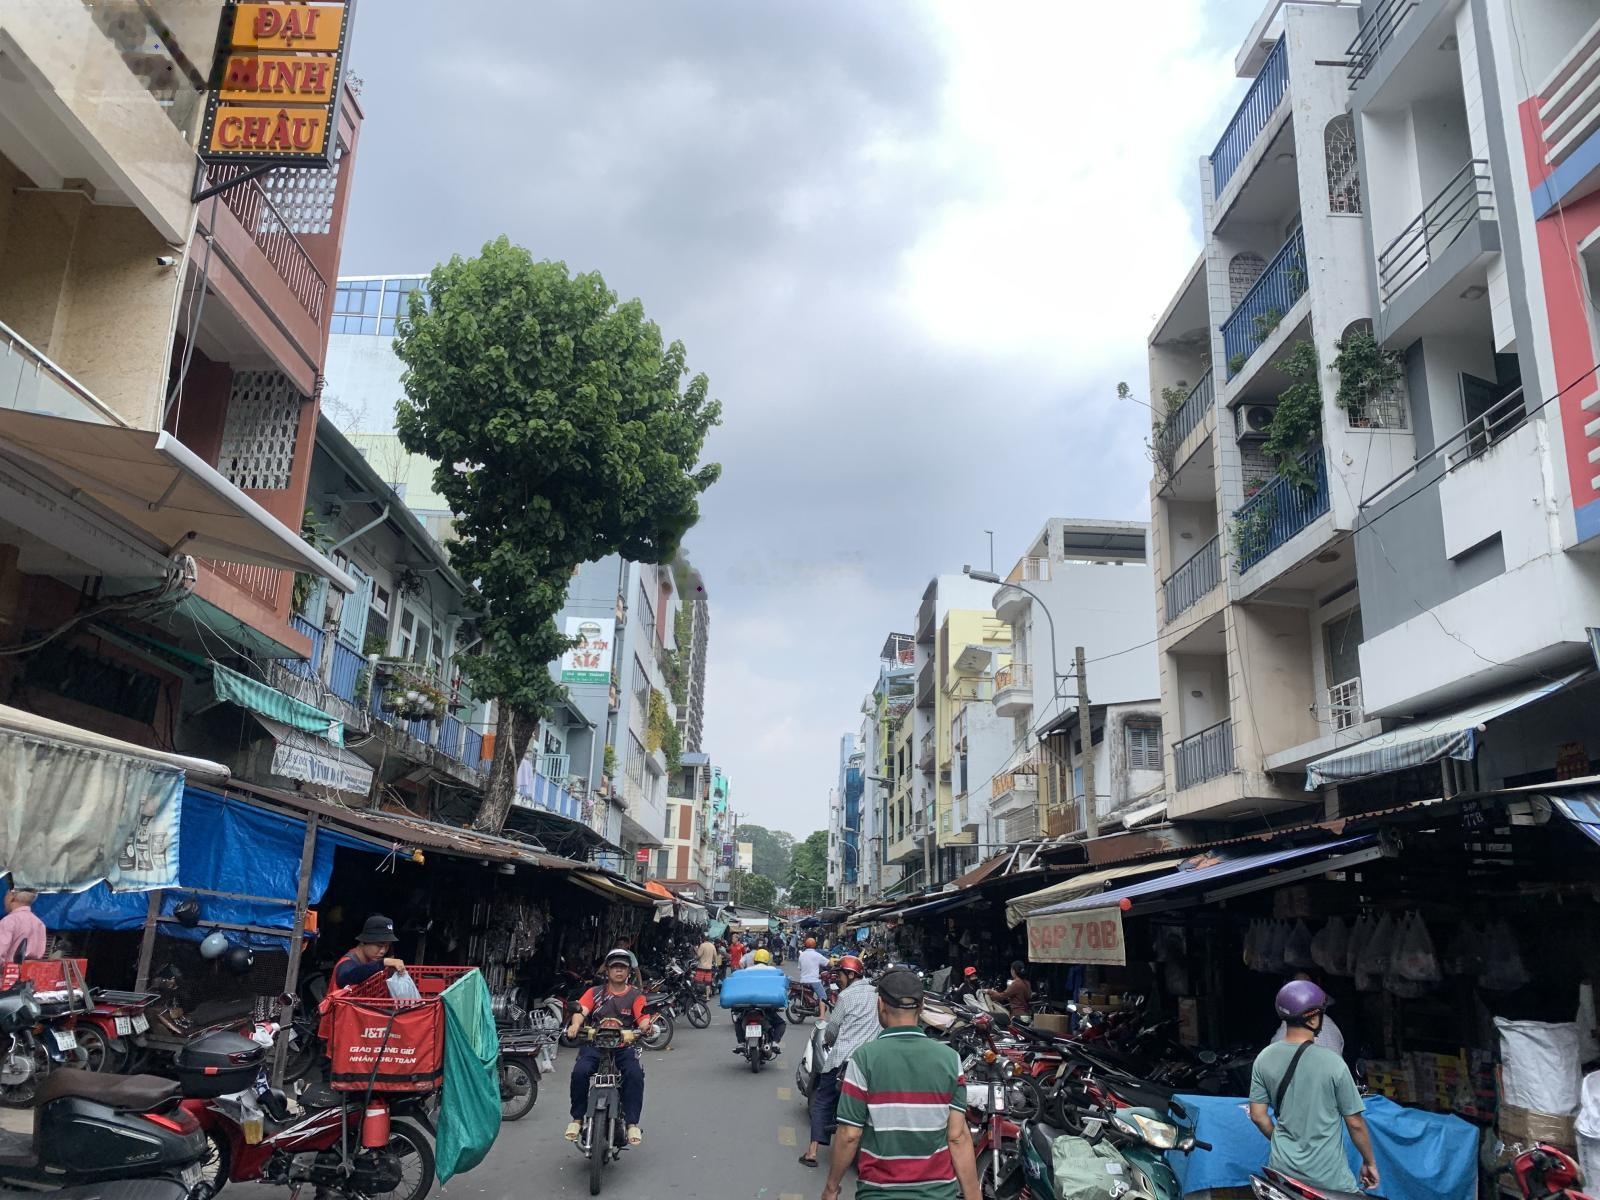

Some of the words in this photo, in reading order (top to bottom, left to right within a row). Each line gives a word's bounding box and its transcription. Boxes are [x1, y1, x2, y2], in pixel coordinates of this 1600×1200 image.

[253, 7, 320, 47] ĐẠI
[224, 58, 329, 94] MINH
[218, 109, 319, 149] CHÂU
[1071, 920, 1119, 951] 78B
[361, 1027, 387, 1039] J&T
